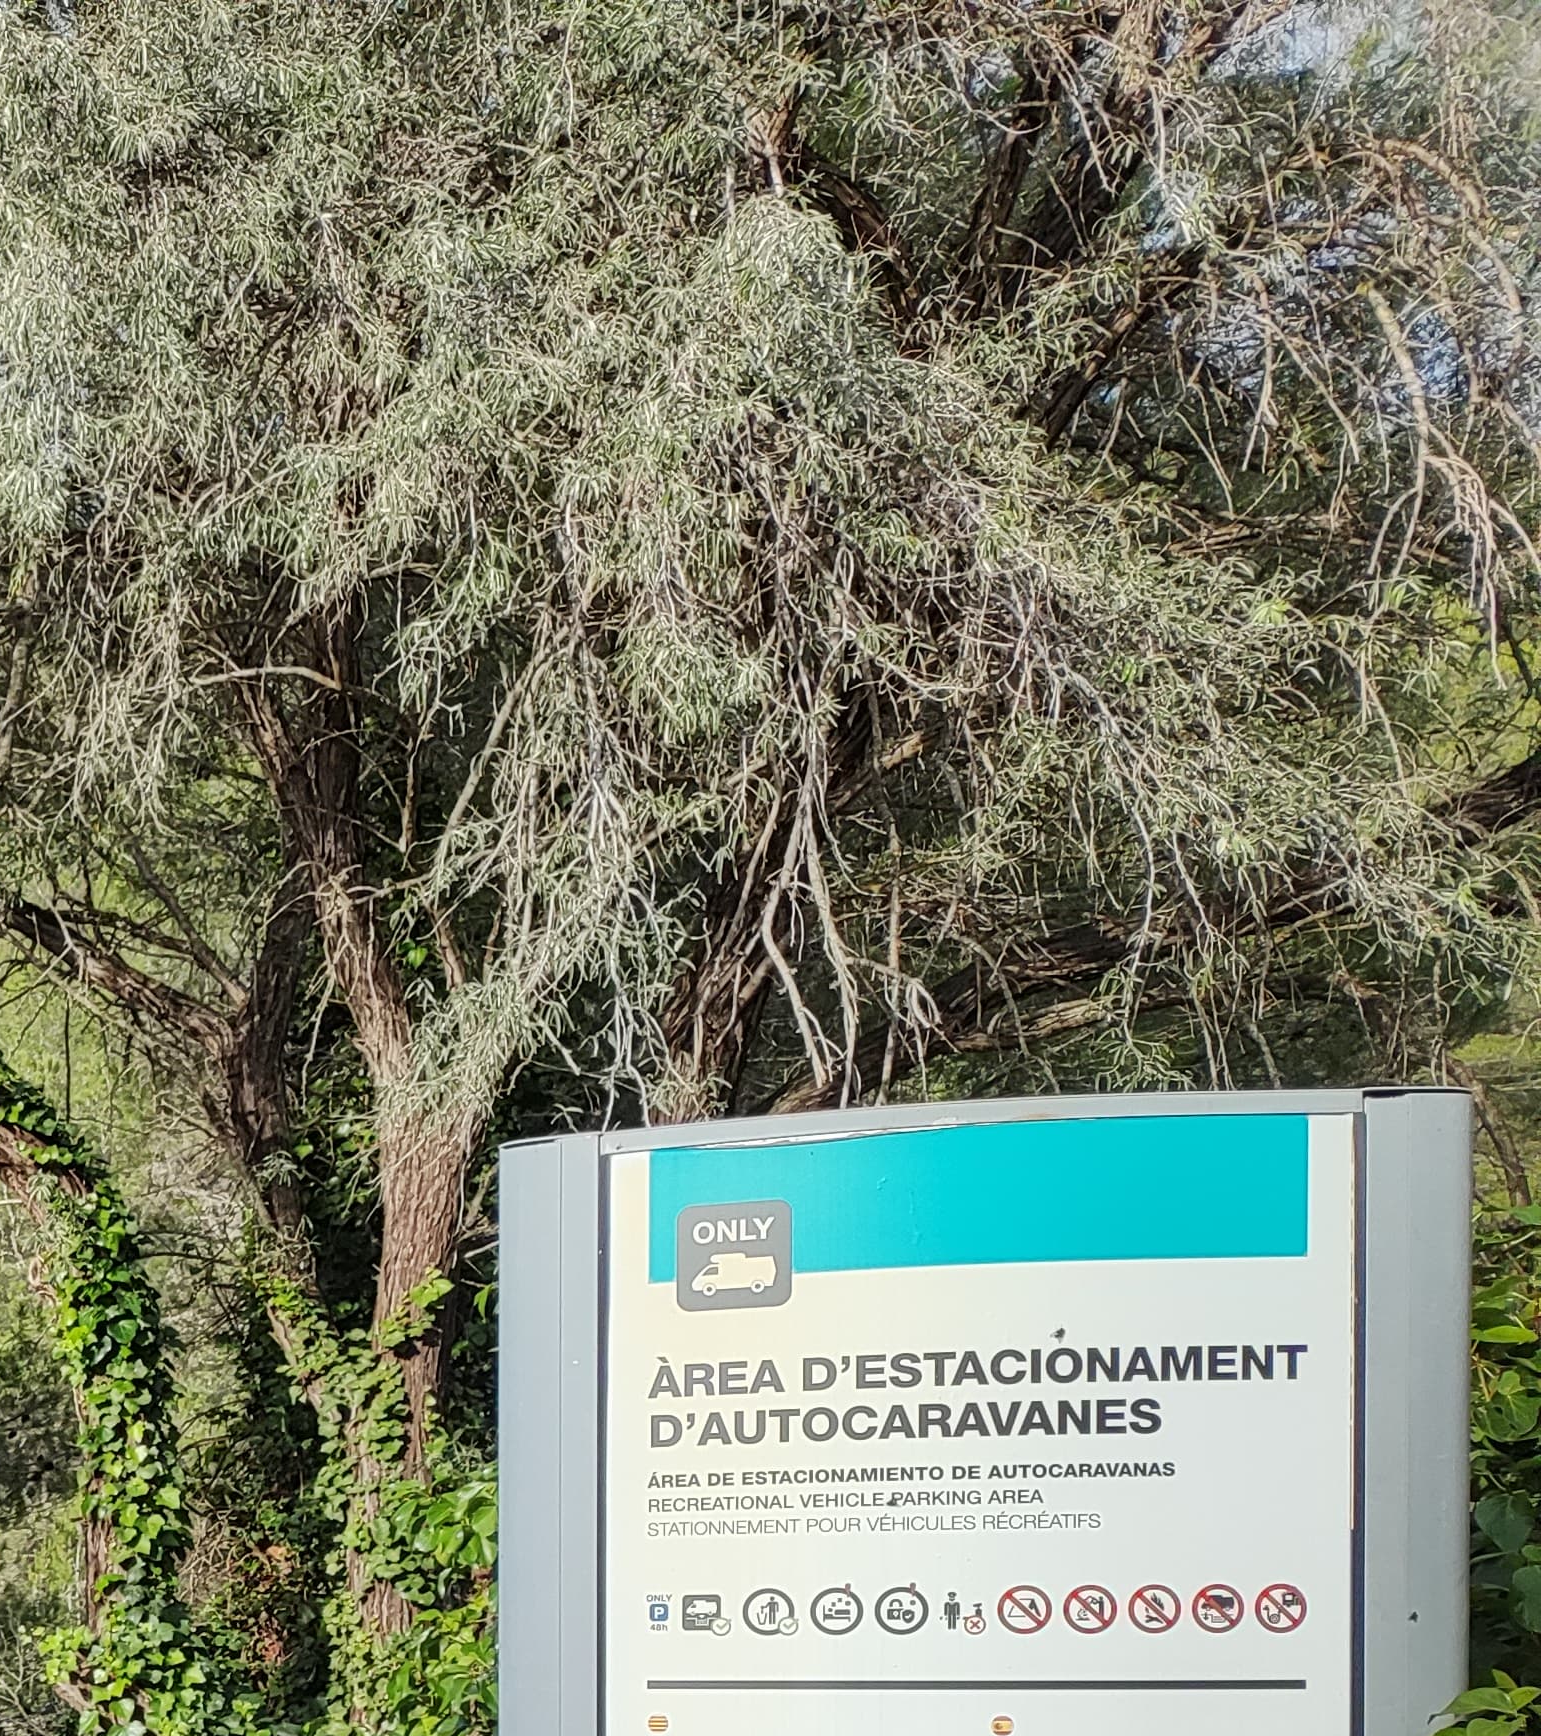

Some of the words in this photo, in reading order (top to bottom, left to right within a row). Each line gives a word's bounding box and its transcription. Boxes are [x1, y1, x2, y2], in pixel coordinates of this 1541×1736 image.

[691, 1216, 775, 1247] ONLY
[649, 1356, 785, 1398] ÀREA
[801, 1344, 1308, 1389] D'ESTACIONAMENT
[651, 1398, 1161, 1447] D'AUTOCARAVANES
[647, 1471, 700, 1488] ÁREA
[708, 1472, 734, 1486] DE
[742, 1466, 943, 1484] ESTACIONAMIENTO
[952, 1465, 980, 1479] DE
[987, 1462, 1175, 1478] AUTOCARAVANAS
[648, 1494, 794, 1512] RECREATIONAL
[800, 1492, 884, 1508] VEHICLE
[890, 1490, 982, 1506] PARKING
[987, 1489, 1043, 1503] AREA
[647, 1518, 800, 1536] STATIONNEMENT
[806, 1517, 860, 1532] POUR
[866, 1513, 975, 1531] VÉHICULES
[983, 1510, 1100, 1529] RÉCRÉATIFS
[646, 1594, 673, 1602] ONLY
